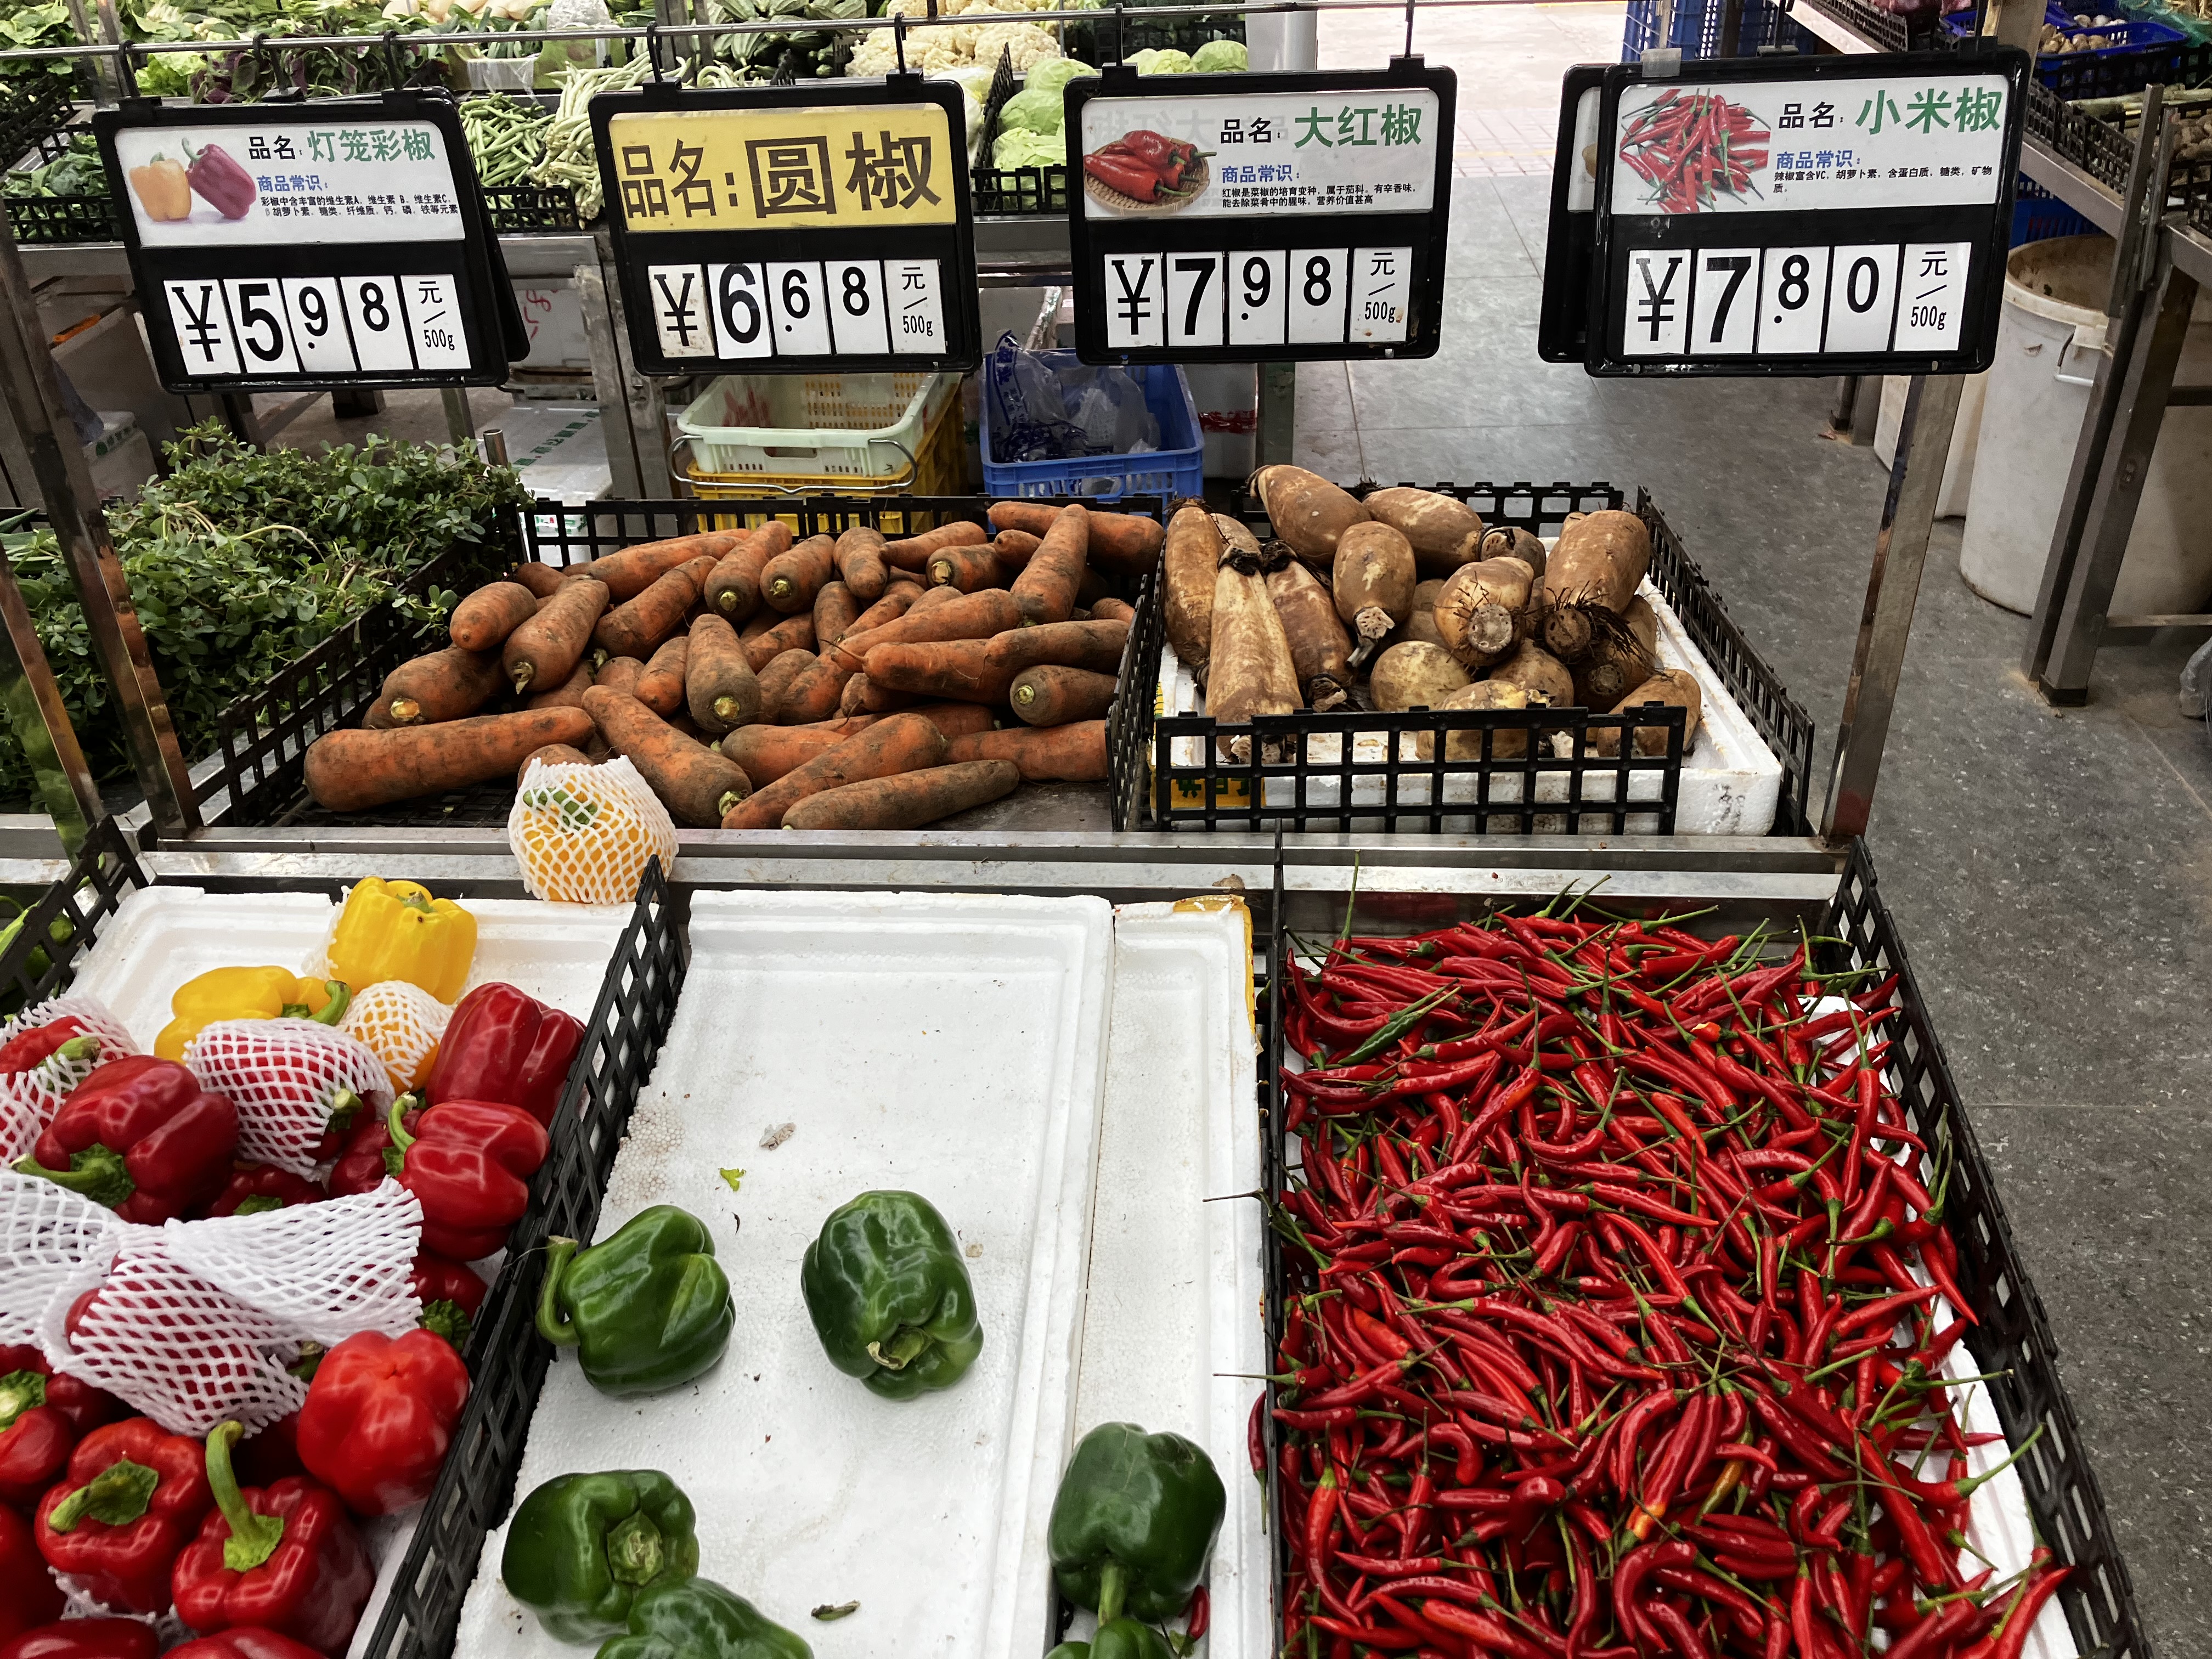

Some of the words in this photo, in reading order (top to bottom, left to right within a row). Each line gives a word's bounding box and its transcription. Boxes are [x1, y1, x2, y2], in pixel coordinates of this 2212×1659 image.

[1855, 87, 2003, 136] 小米椒
[1294, 104, 1422, 149] 大红椒
[307, 128, 436, 162] 灯笼彩椒
[1776, 150, 1862, 170] 商品常识：
[256, 174, 328, 192] 商品常识：
[1221, 165, 1300, 183] 商品常识：
